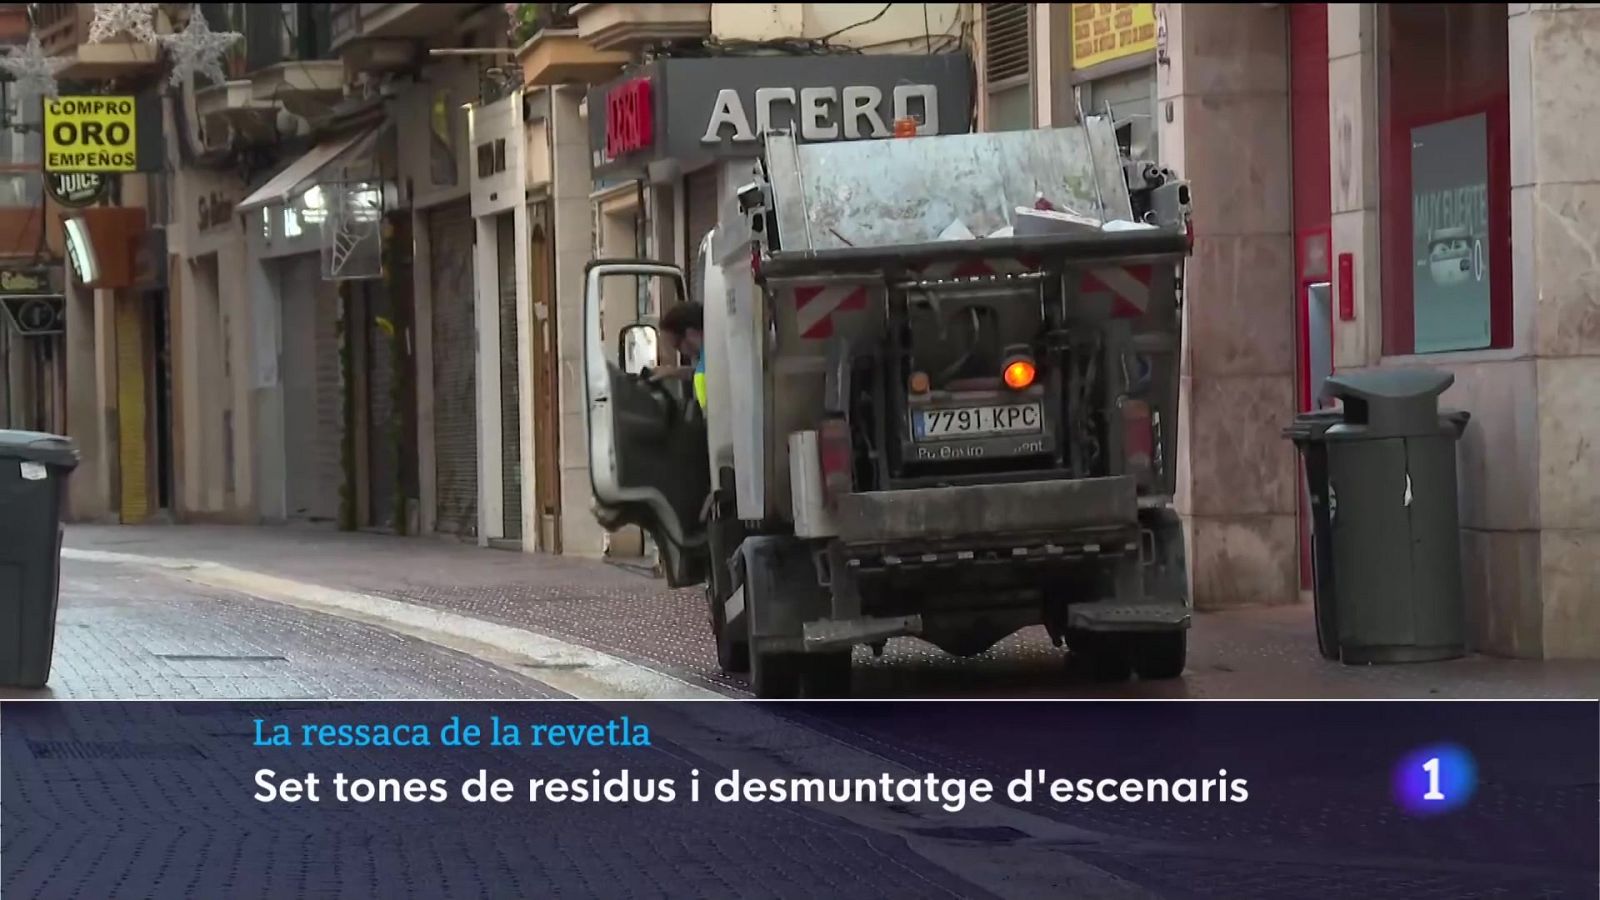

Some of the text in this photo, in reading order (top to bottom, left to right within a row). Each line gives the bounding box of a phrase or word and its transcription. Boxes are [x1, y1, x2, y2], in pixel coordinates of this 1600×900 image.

[49, 99, 132, 116] COMPRO
[701, 84, 939, 143] ACERO
[52, 121, 130, 147] ORO
[48, 150, 135, 168] EMPEÑOS
[56, 172, 100, 196] JUICE
[928, 406, 1036, 432] 7791 KPC
